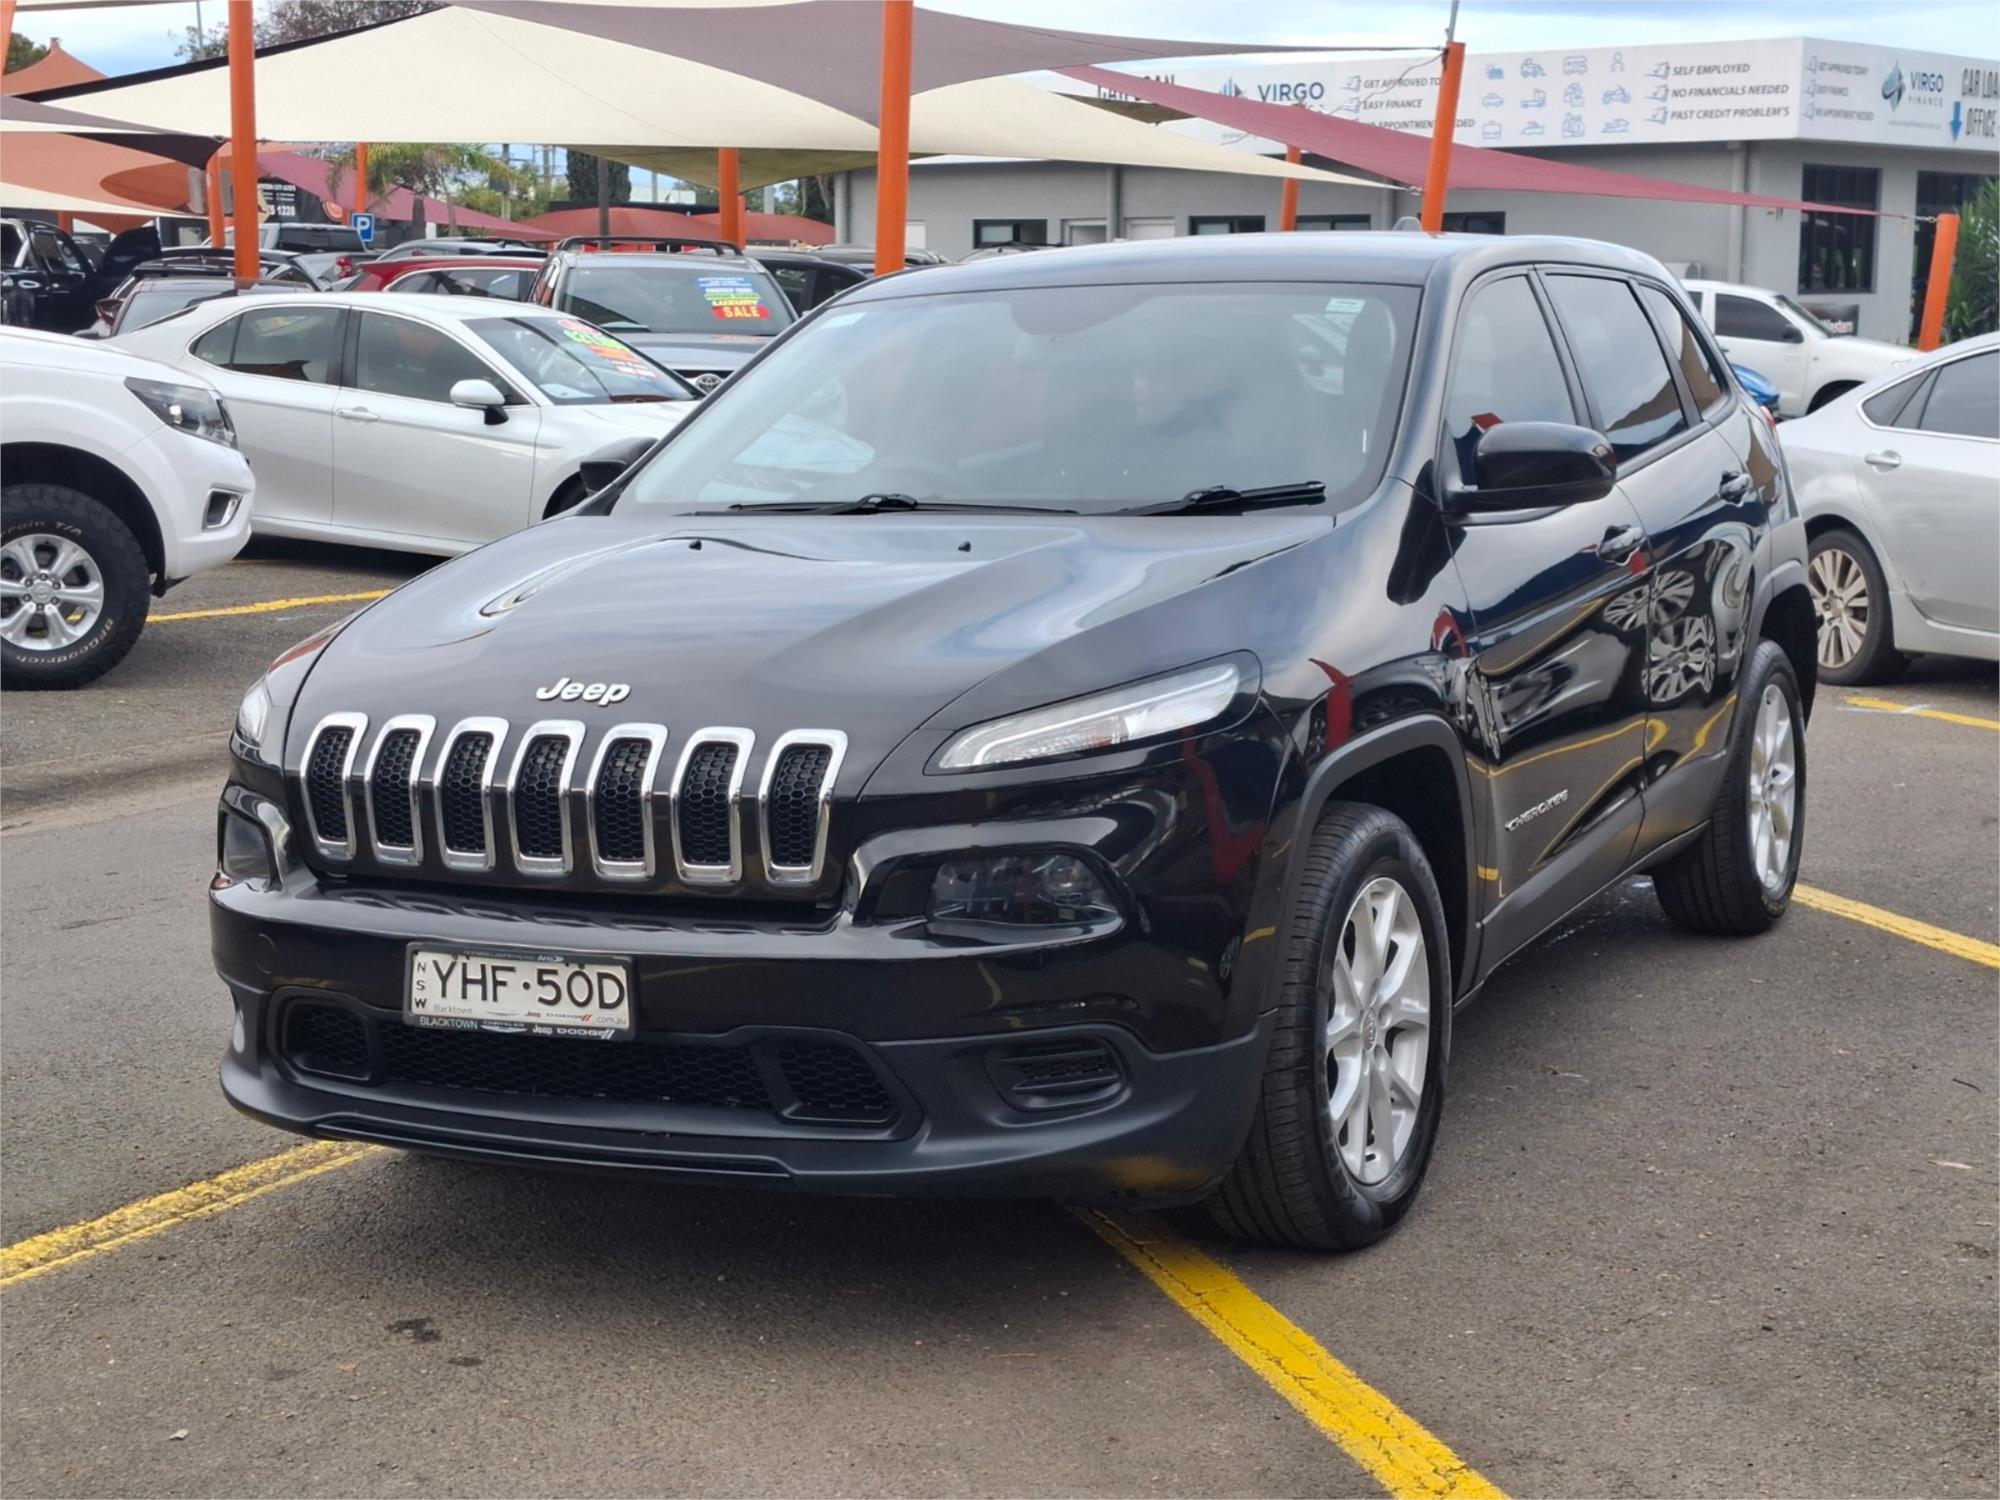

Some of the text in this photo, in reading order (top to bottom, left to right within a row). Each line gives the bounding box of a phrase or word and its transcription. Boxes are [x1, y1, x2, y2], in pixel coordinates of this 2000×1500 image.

[1672, 63, 1751, 76] SELF EMPLOYED
[1363, 79, 1380, 89] GET
[1910, 71, 1944, 93] VIRGO
[1962, 68, 2000, 100] CAR LOA
[1257, 81, 1325, 102] VIRGO
[1671, 84, 1790, 98] NO FINANCIALS NEEDED
[1363, 99, 1423, 110] EASY FINANCE
[1908, 95, 1944, 108] FINANCE
[1671, 106, 1790, 120] PAST CREDIT PROBLEM'S
[1966, 107, 1997, 138] OFFICE
[723, 305, 761, 318] SALE
[535, 677, 632, 707] Jeep
[433, 1004, 474, 1015] Blacktown
[419, 1016, 479, 1031] BLACKTOWN
[532, 1024, 553, 1036] Jeep
